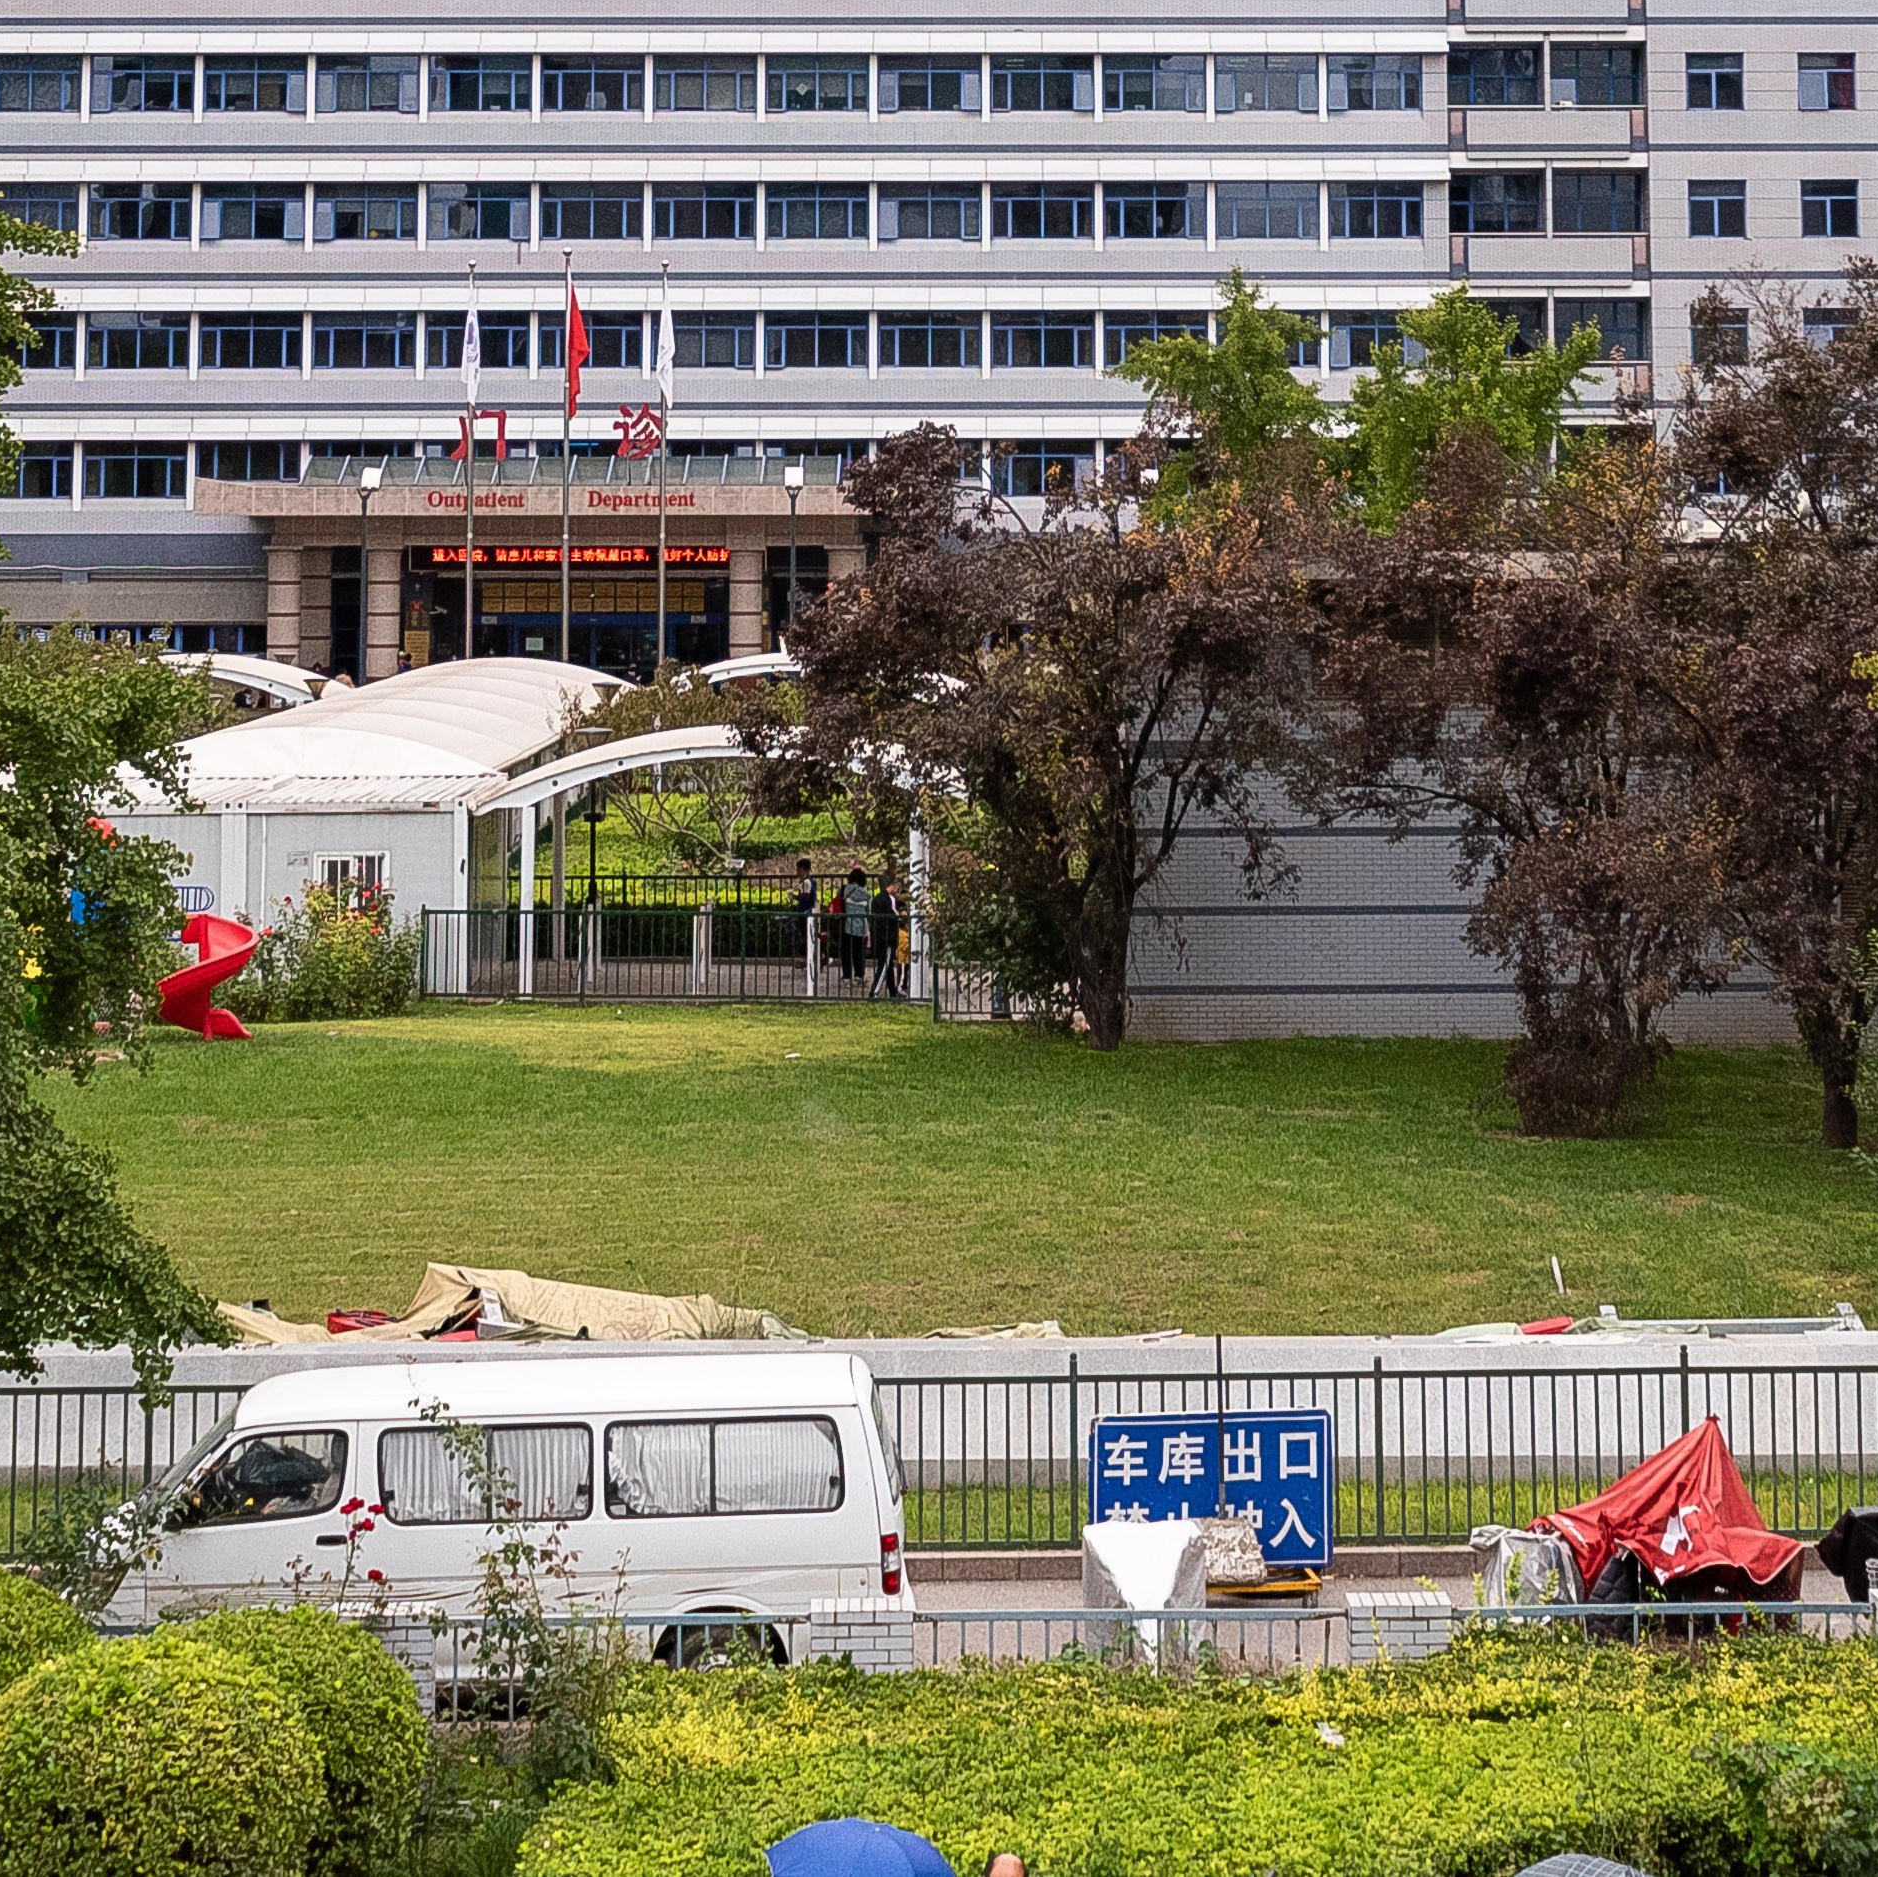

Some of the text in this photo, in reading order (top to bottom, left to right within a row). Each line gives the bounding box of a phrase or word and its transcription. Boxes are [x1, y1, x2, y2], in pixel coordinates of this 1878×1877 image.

[450, 402, 668, 461] 门诊
[1104, 1430, 1318, 1485] 车库出口
